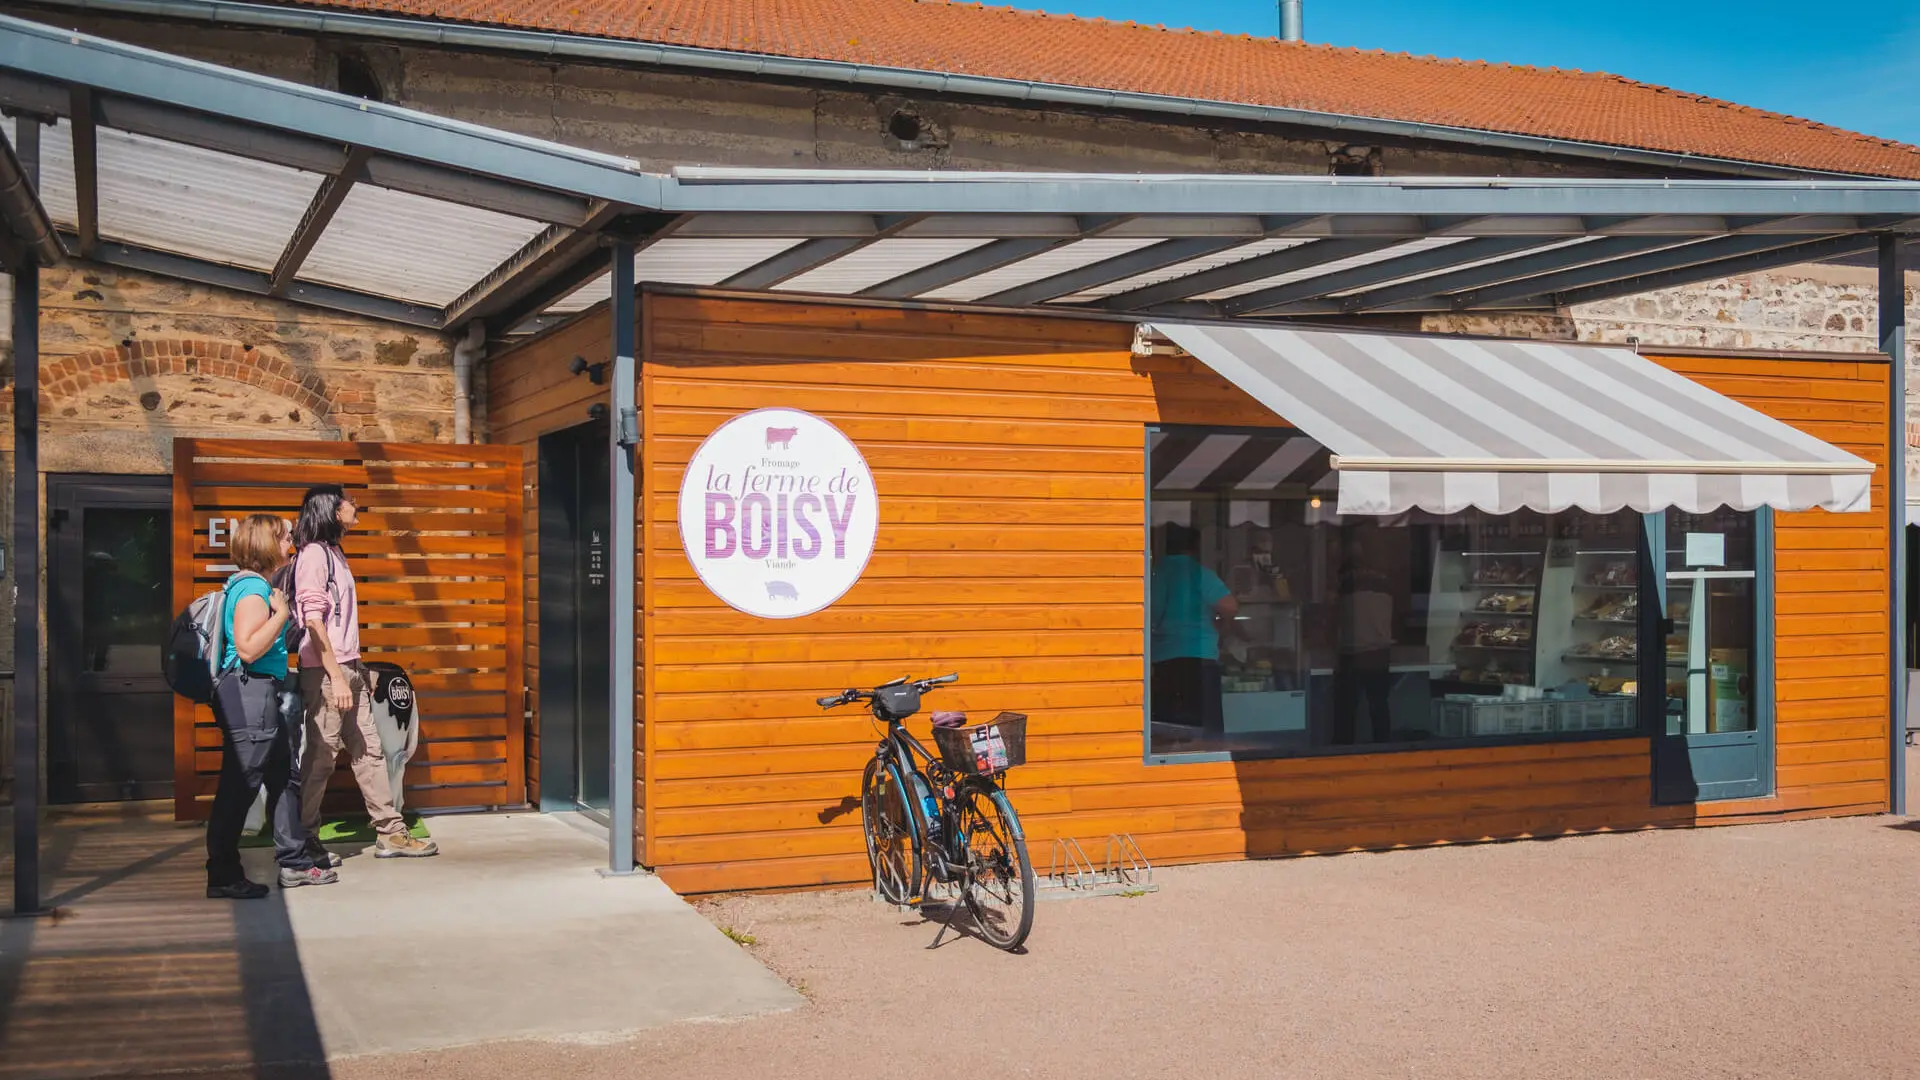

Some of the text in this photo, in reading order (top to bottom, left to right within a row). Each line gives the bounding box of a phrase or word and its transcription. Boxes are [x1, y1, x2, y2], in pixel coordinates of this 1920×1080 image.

[761, 458, 801, 469] Fromage
[706, 464, 860, 500] la ferme de
[705, 492, 857, 559] BOISY
[765, 559, 796, 569] Viande
[391, 688, 410, 701] BOISY
